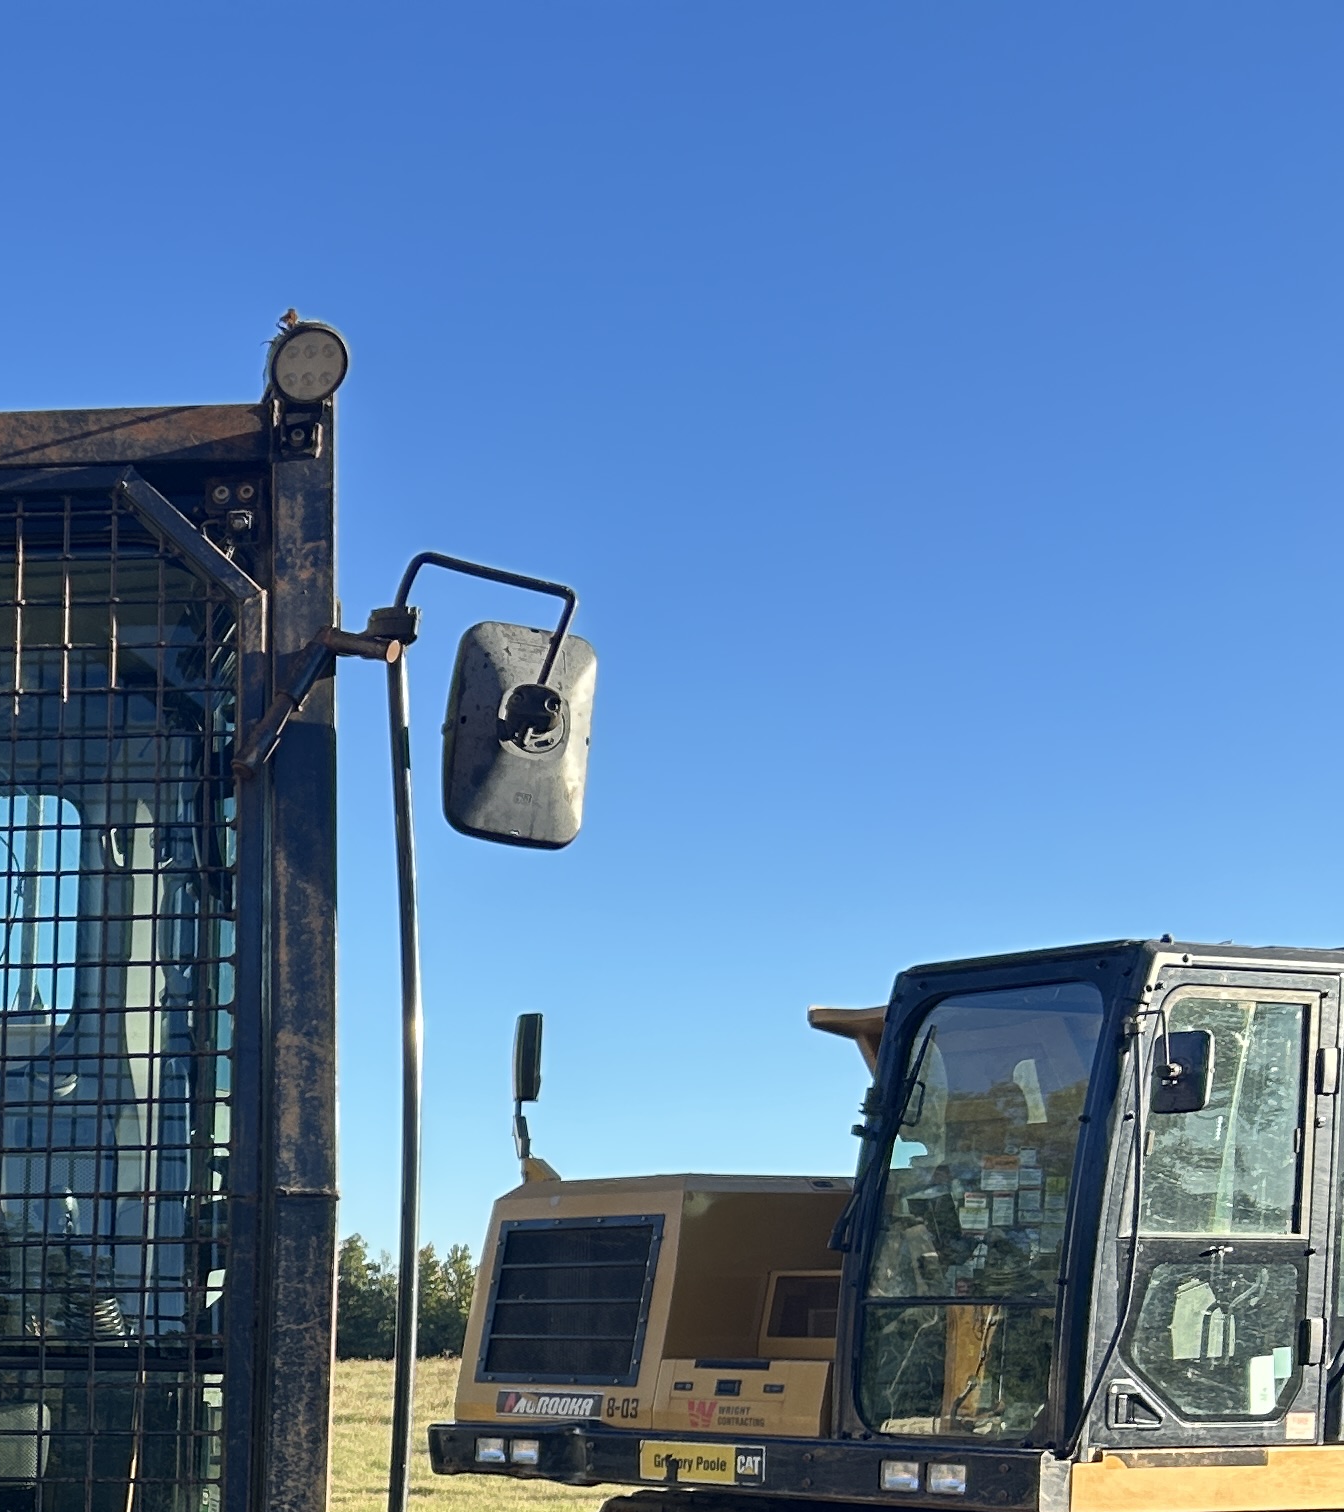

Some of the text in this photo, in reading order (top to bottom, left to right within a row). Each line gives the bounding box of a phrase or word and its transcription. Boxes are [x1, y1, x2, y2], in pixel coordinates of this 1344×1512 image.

[718, 1406, 751, 1416] WRIGHT
[717, 1416, 765, 1428] CONTRACTING
[653, 1453, 727, 1473] Grory Poole
[736, 1455, 761, 1475] CAT
